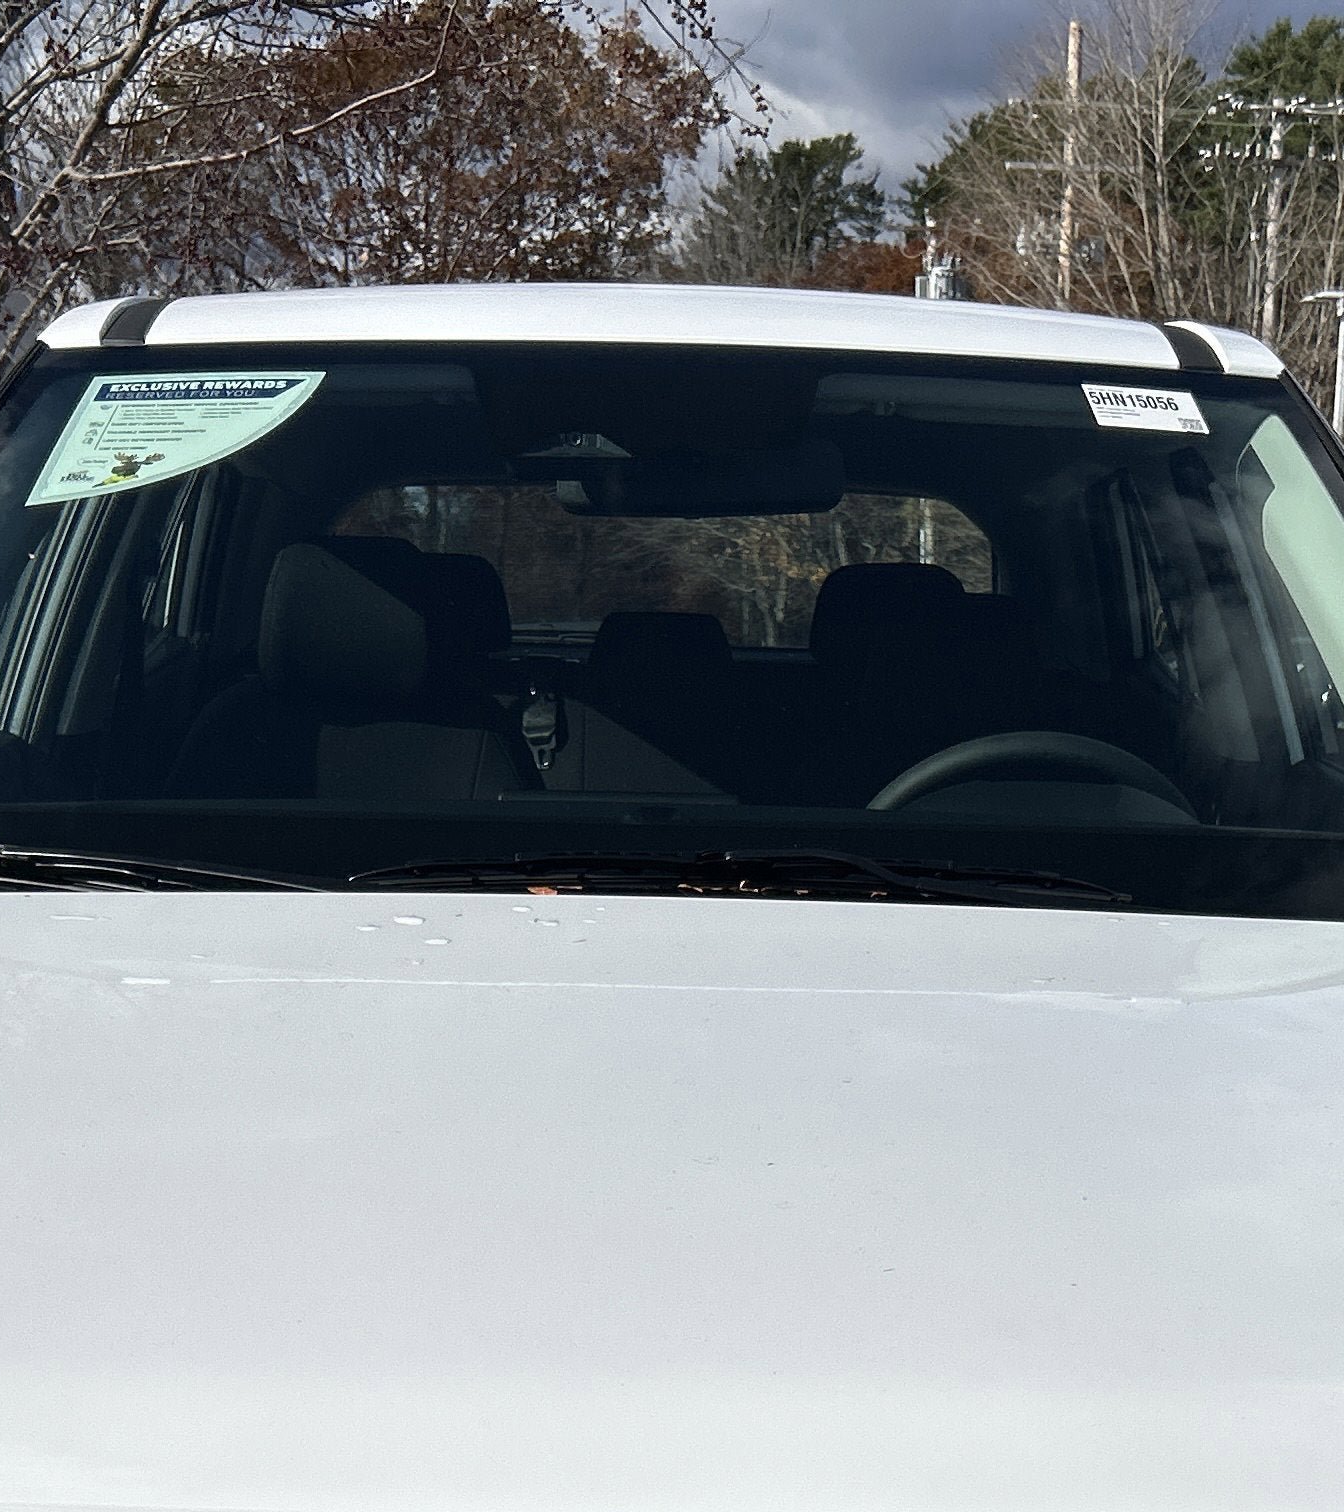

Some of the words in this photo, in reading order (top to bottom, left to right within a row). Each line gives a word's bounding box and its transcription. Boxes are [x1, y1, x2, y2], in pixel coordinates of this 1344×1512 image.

[109, 381, 201, 392] EXCLUSIVE
[205, 380, 287, 390] REWARDS
[105, 391, 186, 400] RESERVED
[190, 390, 222, 399] FOR
[1088, 391, 1179, 411] 5HN15056
